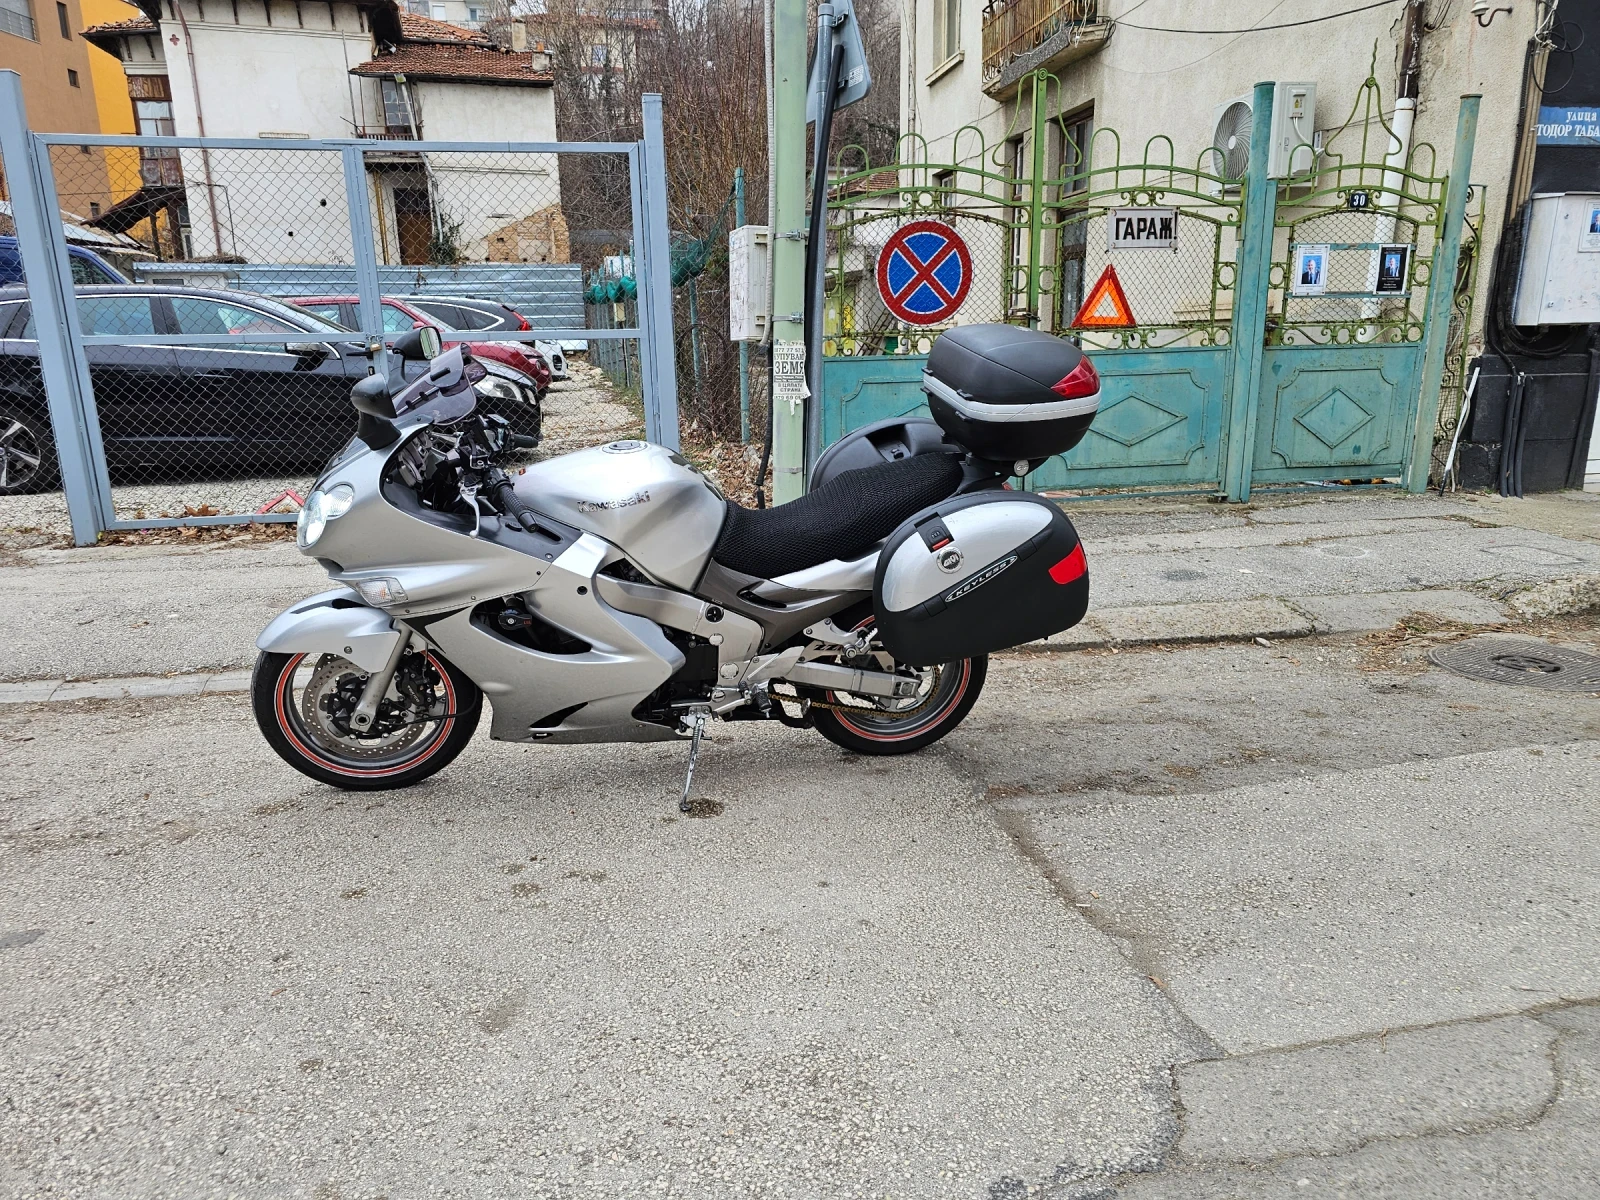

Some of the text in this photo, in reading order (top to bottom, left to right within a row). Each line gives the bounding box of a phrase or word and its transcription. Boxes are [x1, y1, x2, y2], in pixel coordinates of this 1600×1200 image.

[1566, 111, 1597, 123] улица
[1537, 124, 1572, 138] ТОДОР
[1353, 194, 1366, 206] 30
[1114, 211, 1178, 241] ГАРАЖ!
[775, 361, 804, 374] ЗЕМЯ
[577, 491, 651, 513] Kawasaki
[955, 560, 1008, 596] KEYLESS
